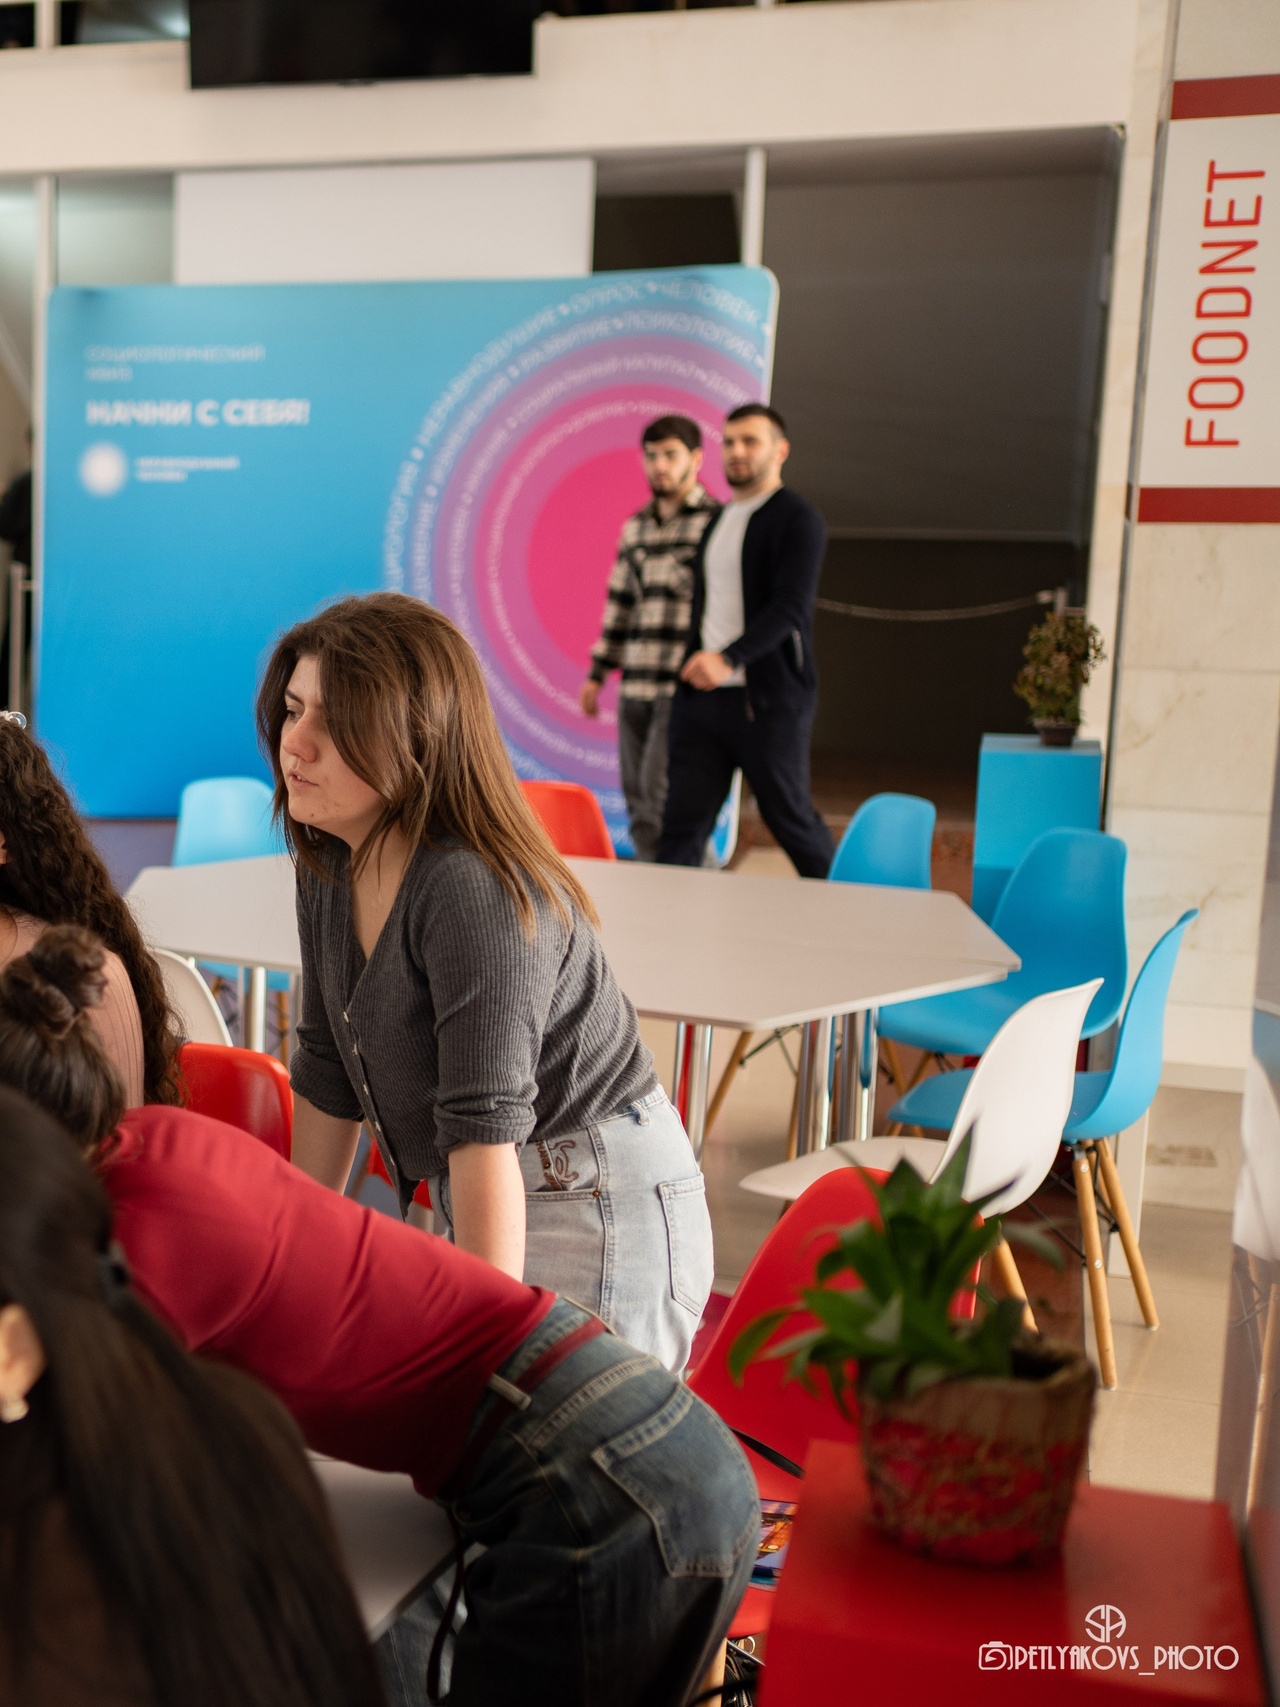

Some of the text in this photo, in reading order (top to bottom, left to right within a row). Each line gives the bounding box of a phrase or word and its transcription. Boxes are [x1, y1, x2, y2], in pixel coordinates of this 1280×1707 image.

[1184, 159, 1266, 447] FOODNET
[86, 399, 310, 426] НАЧНИ С СЕБЯ!
